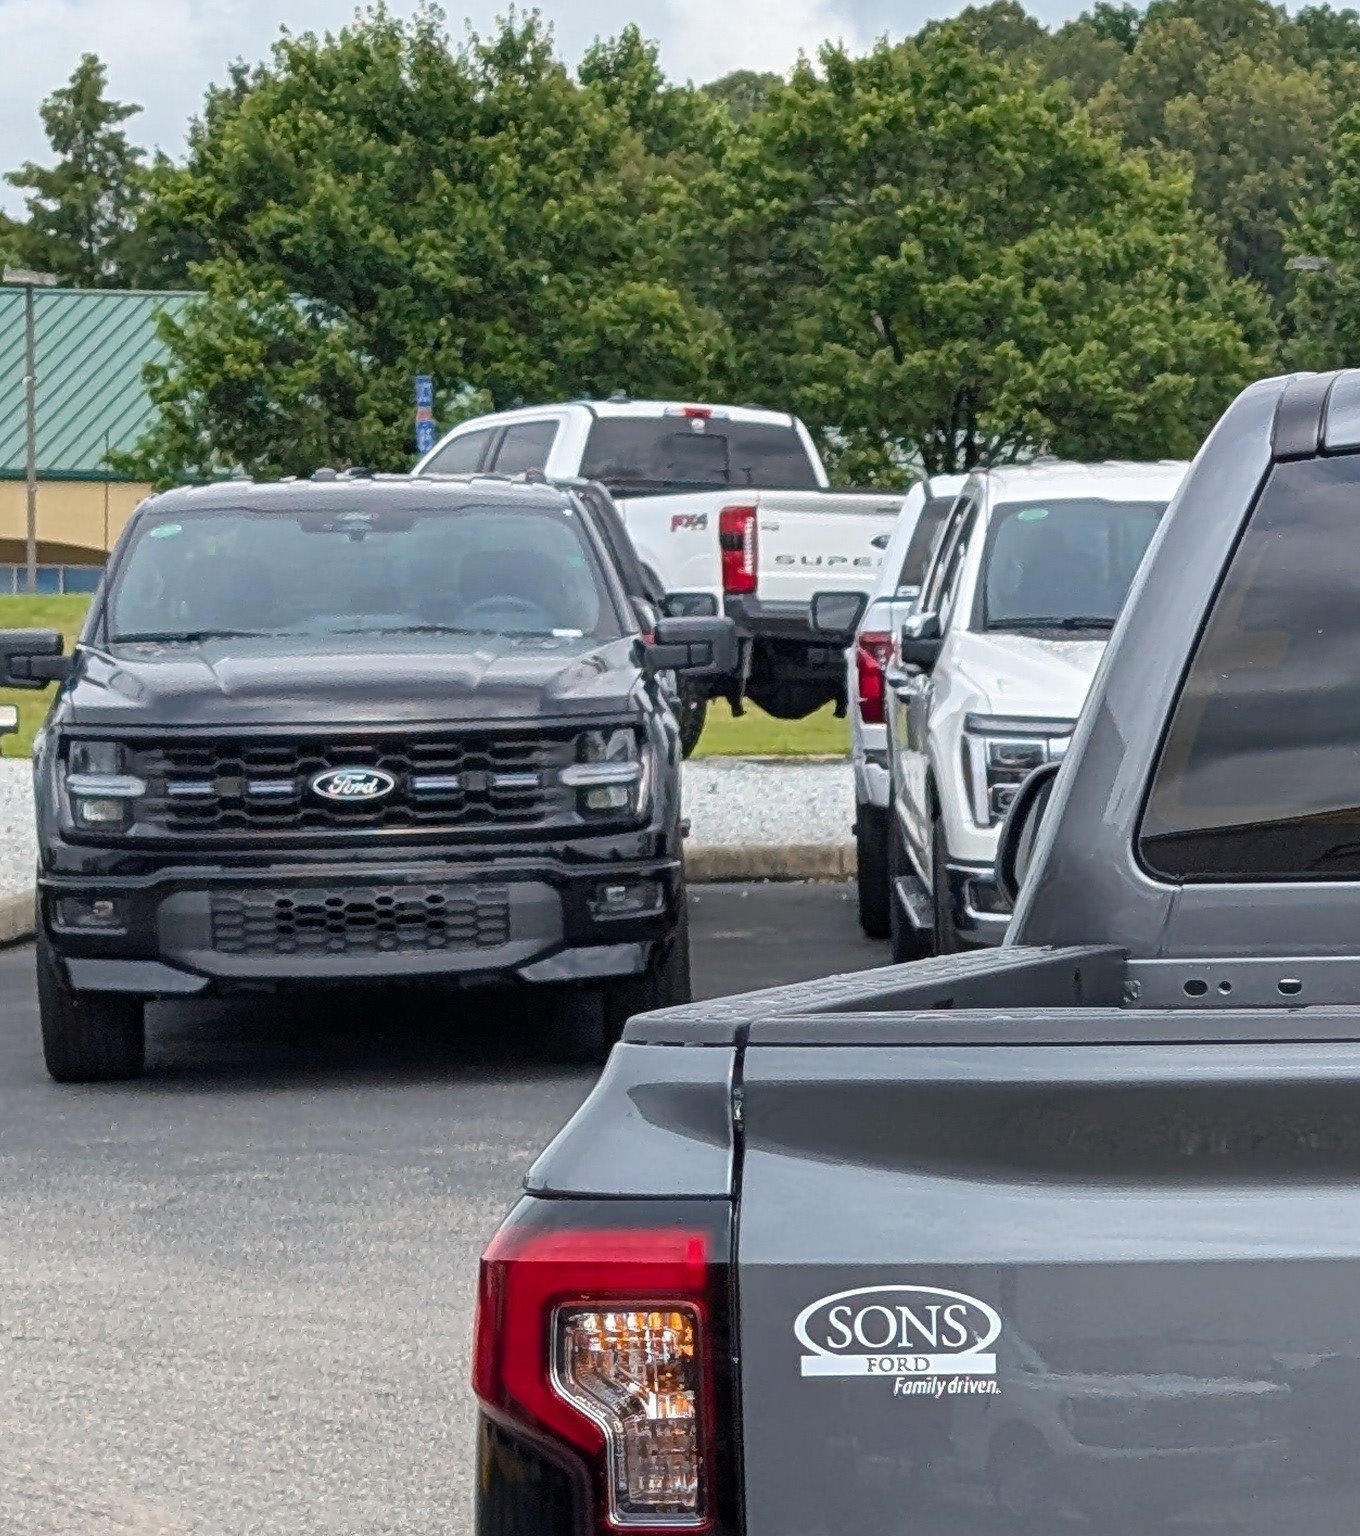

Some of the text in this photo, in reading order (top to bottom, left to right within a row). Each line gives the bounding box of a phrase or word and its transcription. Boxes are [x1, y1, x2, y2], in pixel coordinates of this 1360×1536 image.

[670, 513, 708, 533] FX4
[775, 553, 883, 568] SUPE
[327, 772, 380, 795] Ford
[827, 1304, 968, 1349] SONS
[867, 1357, 931, 1373] FORD
[893, 1376, 946, 1399] Family
